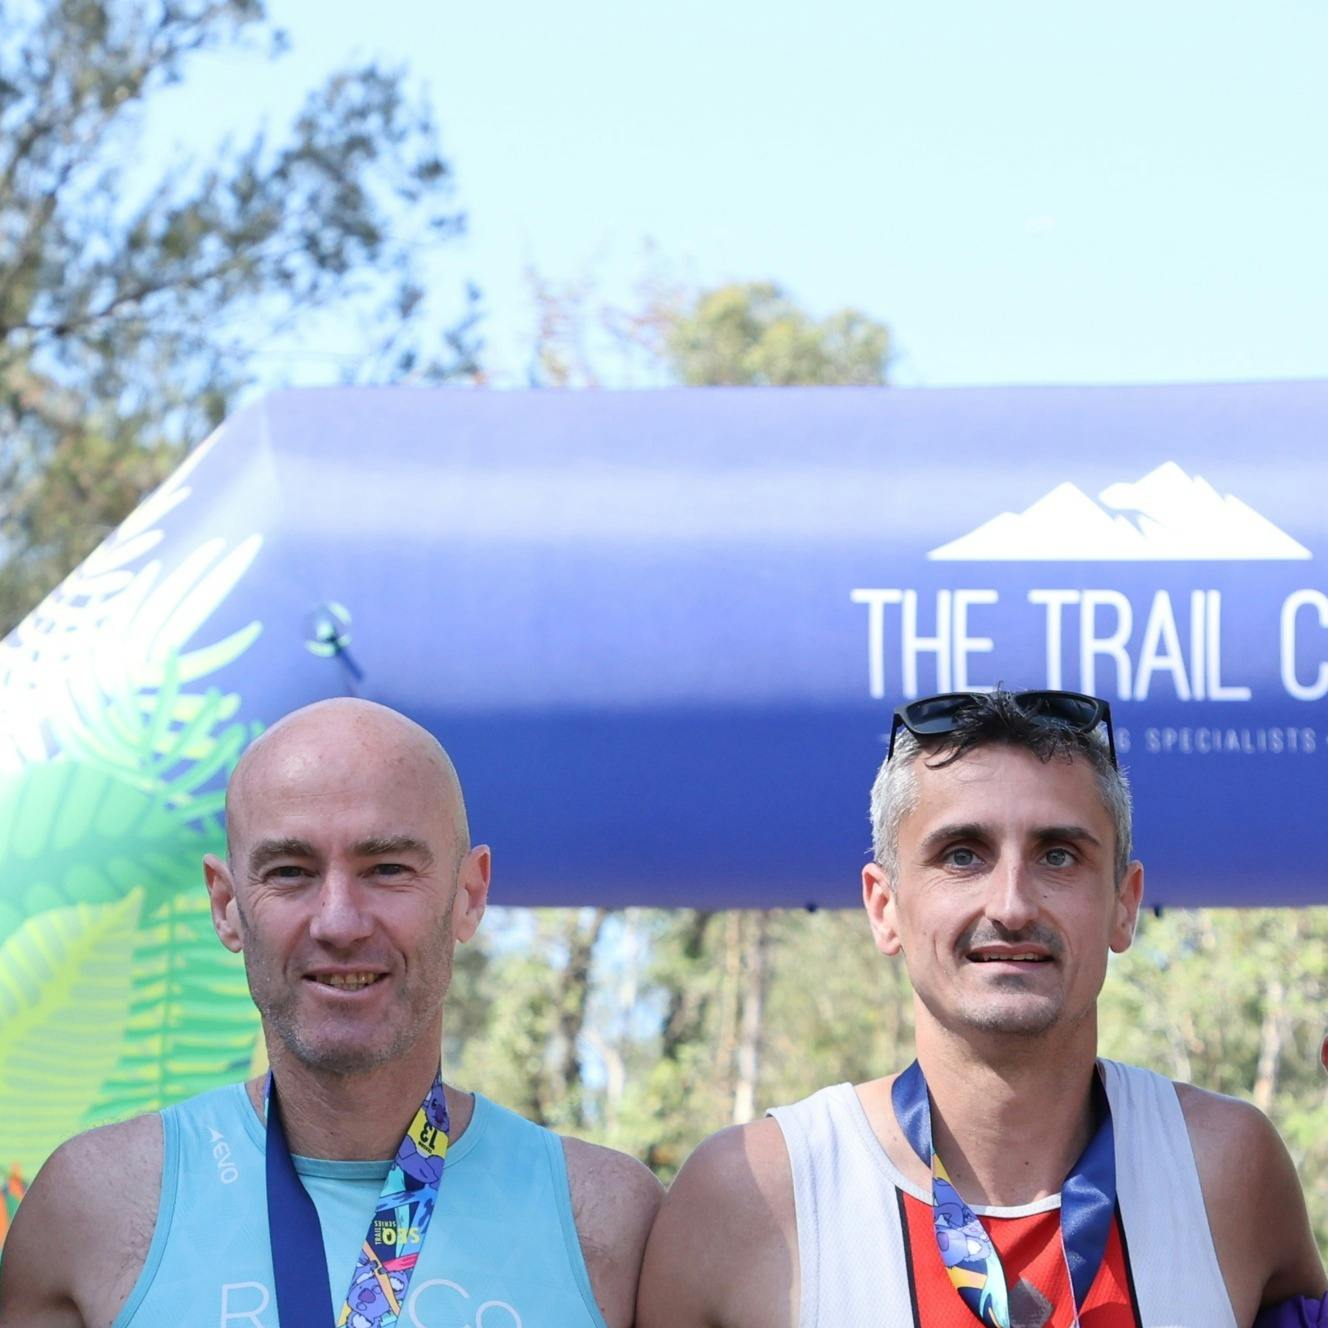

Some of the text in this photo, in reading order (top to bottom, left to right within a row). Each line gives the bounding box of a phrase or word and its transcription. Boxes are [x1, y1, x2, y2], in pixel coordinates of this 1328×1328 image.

[850, 588, 999, 701] THE
[1027, 588, 1253, 702] TRAIL
[1145, 727, 1317, 754] SPECIALISTS
